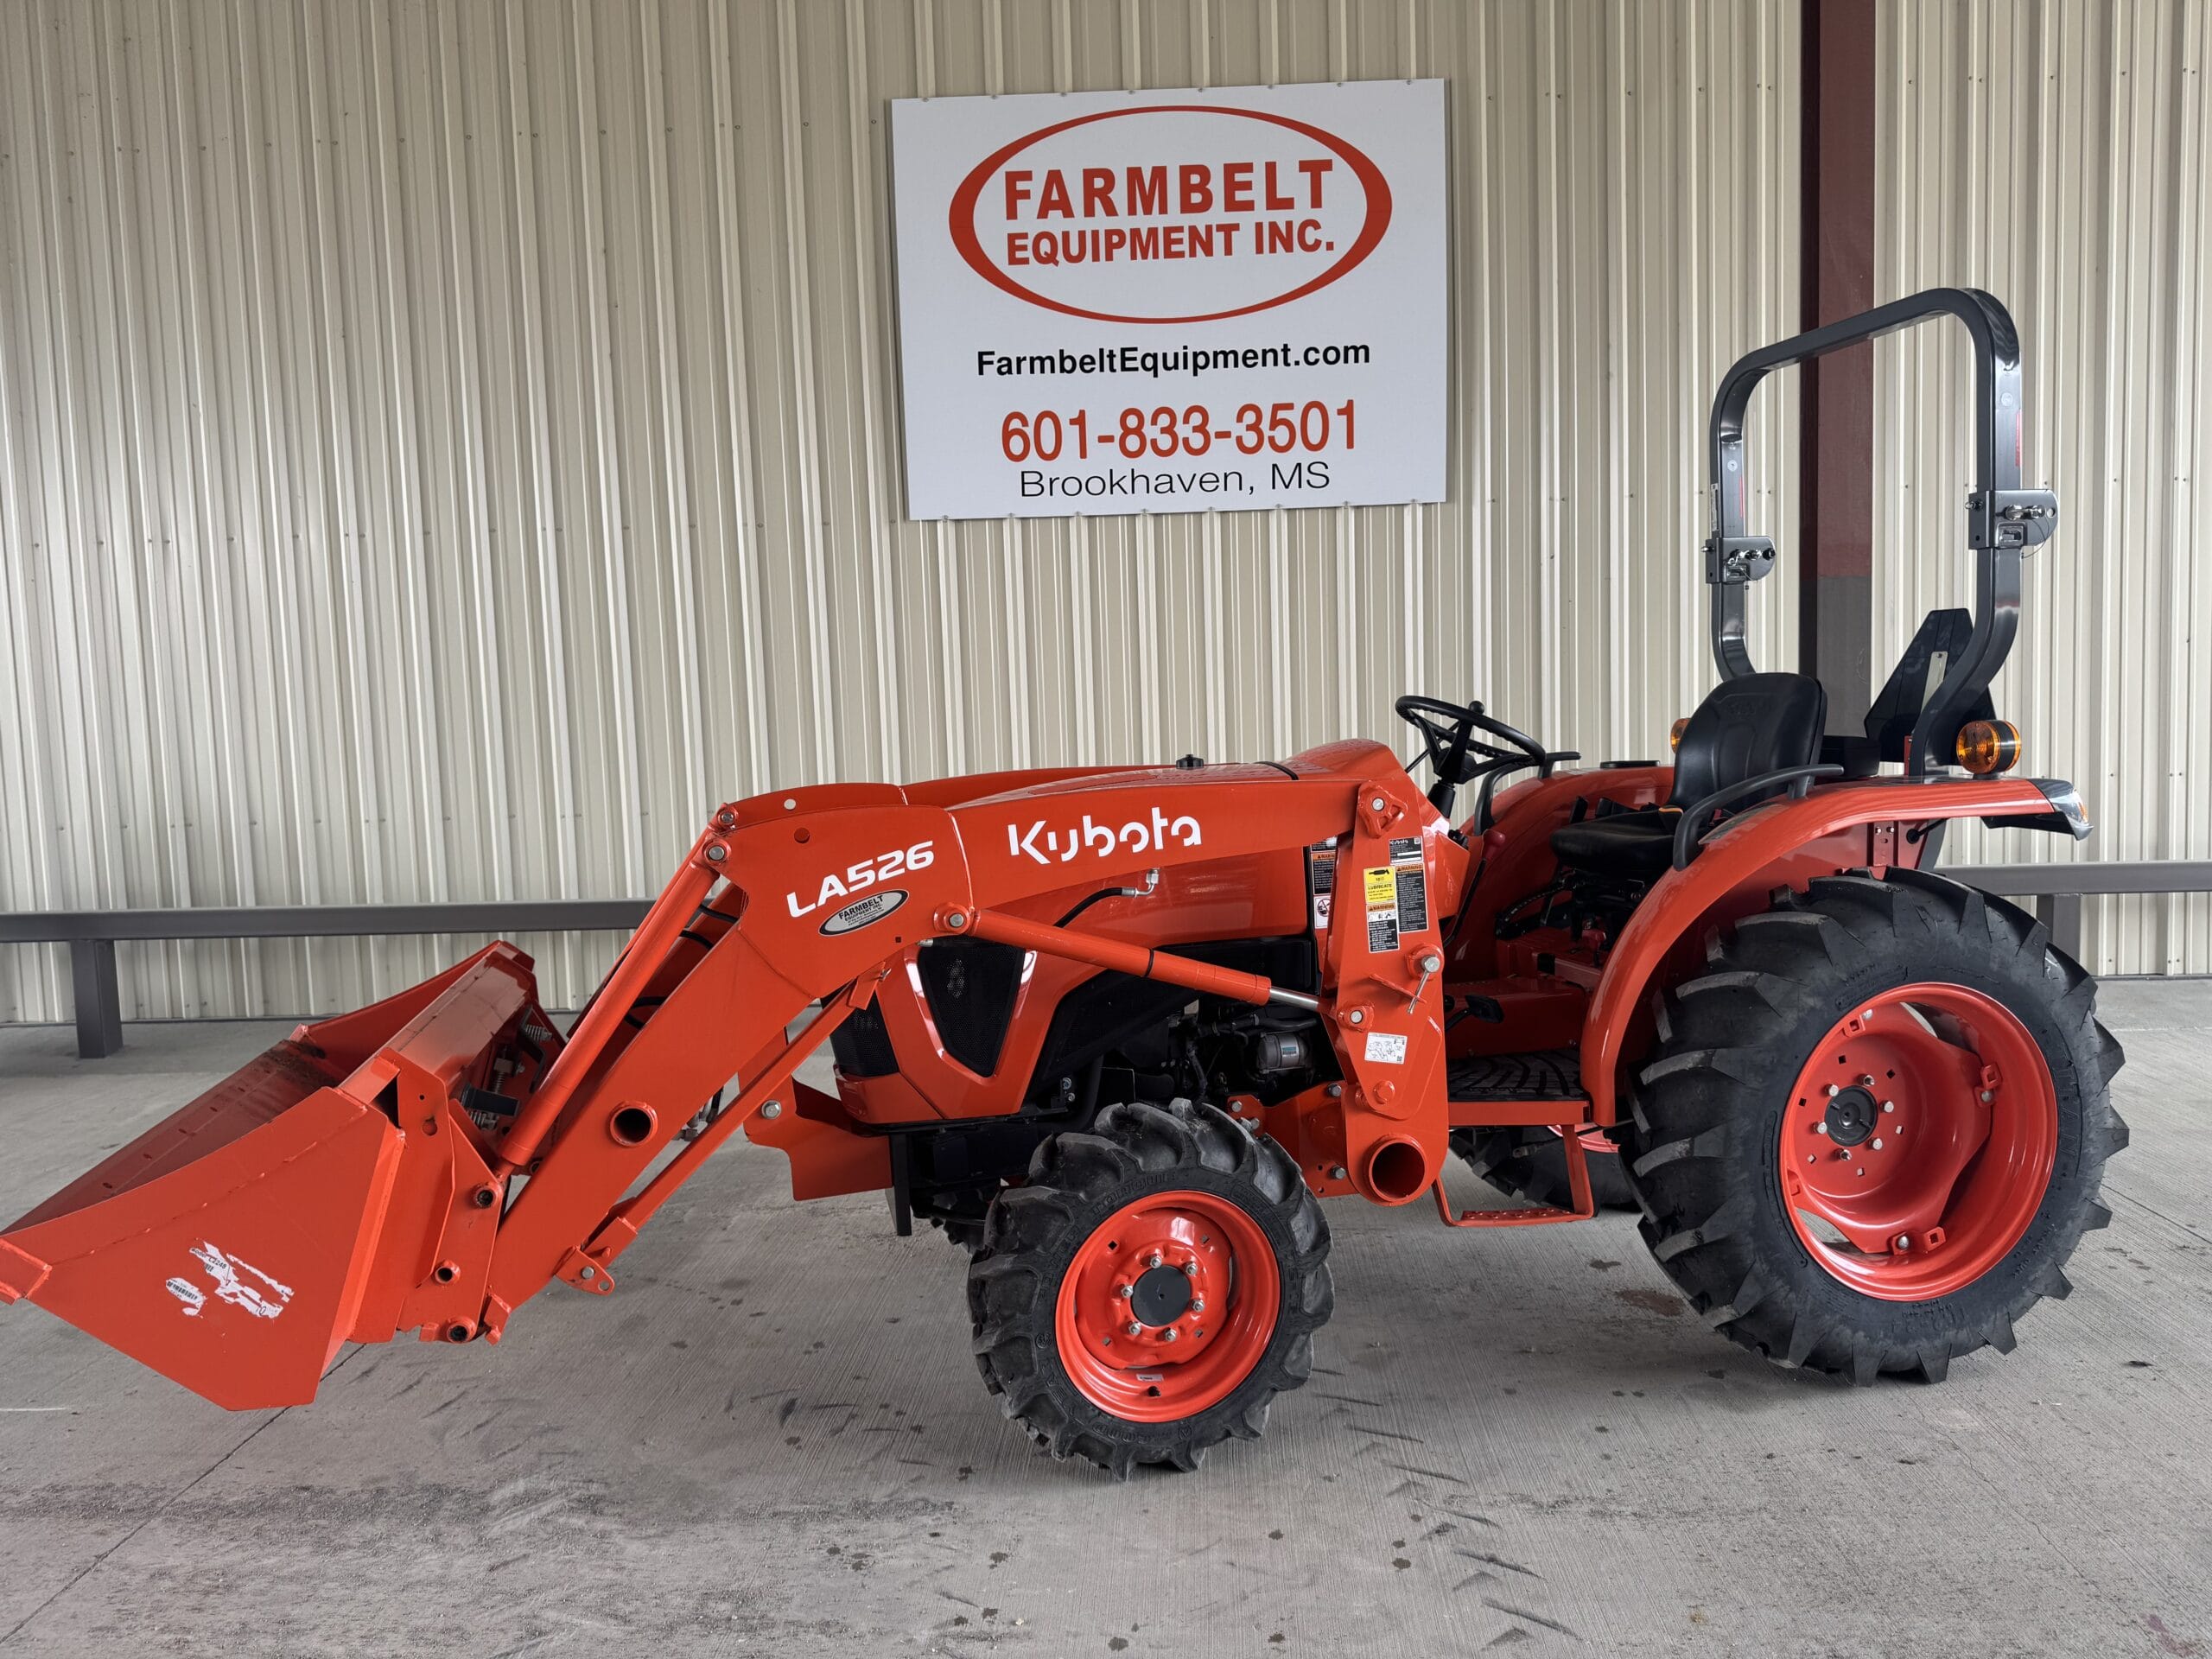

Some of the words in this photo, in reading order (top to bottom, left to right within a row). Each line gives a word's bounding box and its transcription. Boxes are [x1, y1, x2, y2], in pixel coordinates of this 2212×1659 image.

[1004, 158, 1333, 221] FARMBELT
[1007, 223, 1241, 266] EQUIPMENT
[1255, 218, 1336, 255] INC.
[976, 342, 1370, 378] FarmbeltEquipment.com
[1001, 398, 1357, 462] 601-833-3501
[1020, 467, 1255, 498] Brookhaven,
[1270, 461, 1331, 490] MS
[1008, 807, 1203, 865] Kubota
[786, 840, 935, 918] LA526
[838, 895, 883, 919] FARMBELT
